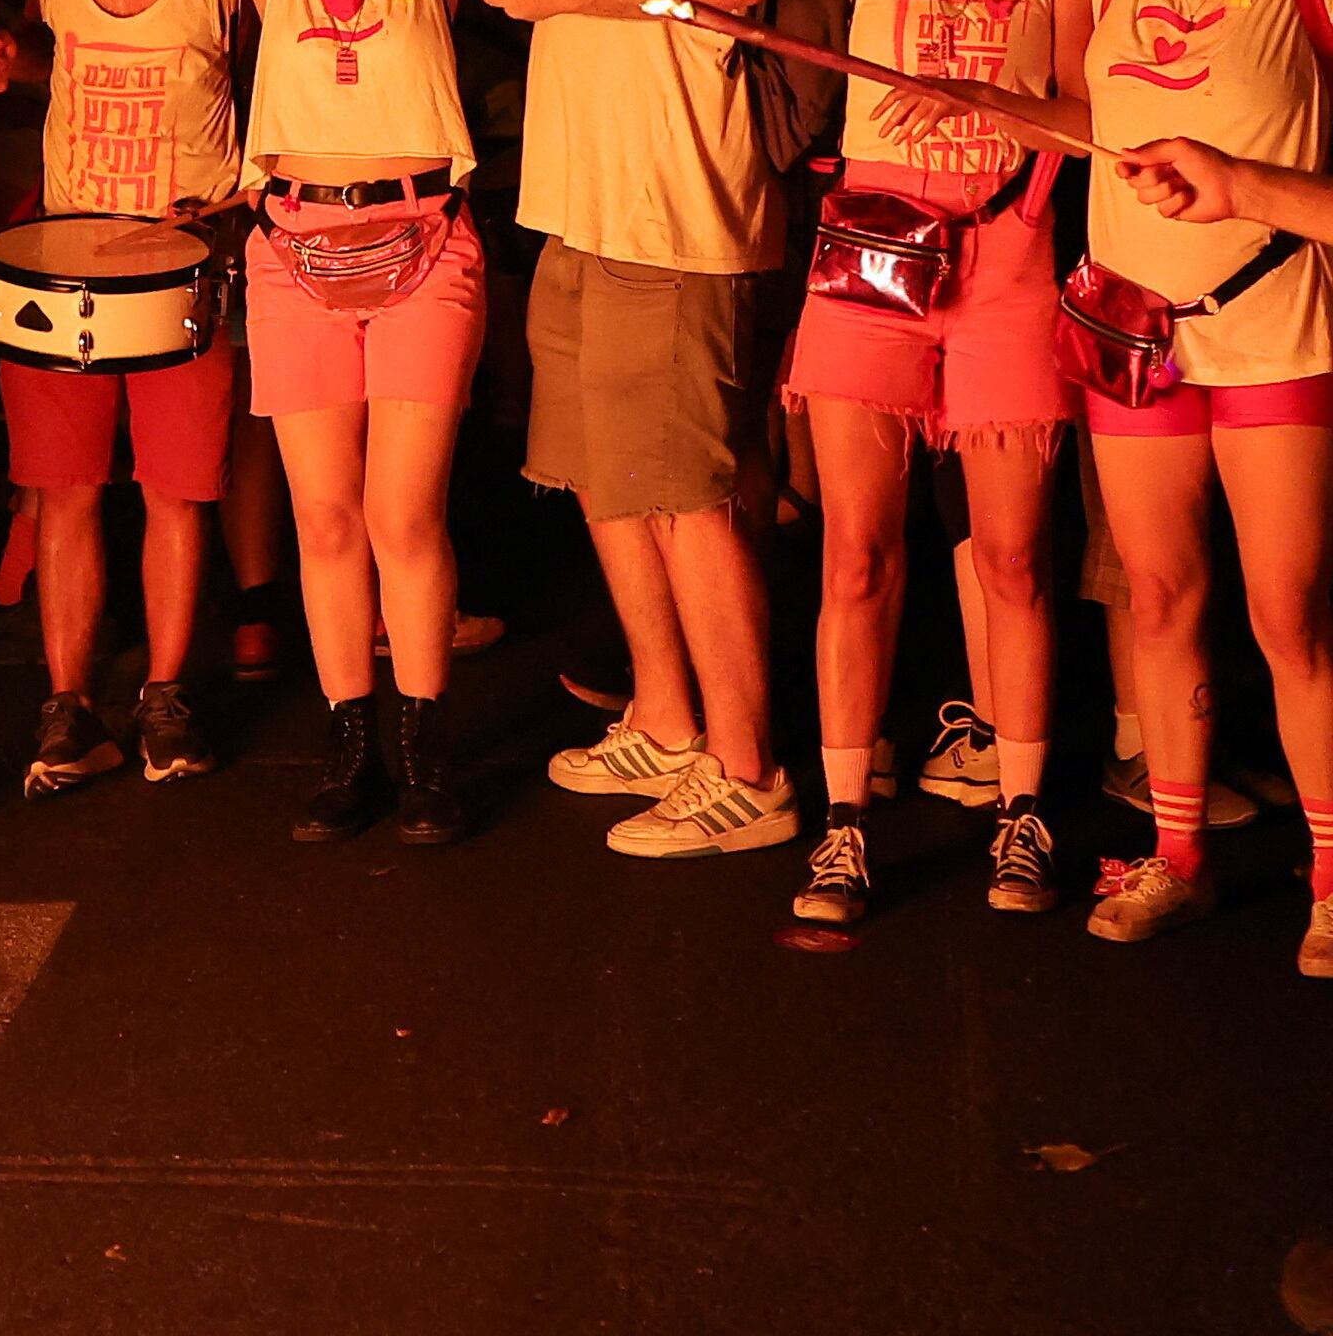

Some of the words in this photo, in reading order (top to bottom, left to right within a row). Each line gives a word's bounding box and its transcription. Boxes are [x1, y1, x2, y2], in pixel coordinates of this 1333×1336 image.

[84, 65, 129, 89] שלם
[134, 67, 166, 88] דור
[84, 98, 164, 136] דורש
[82, 136, 161, 174] עתיד
